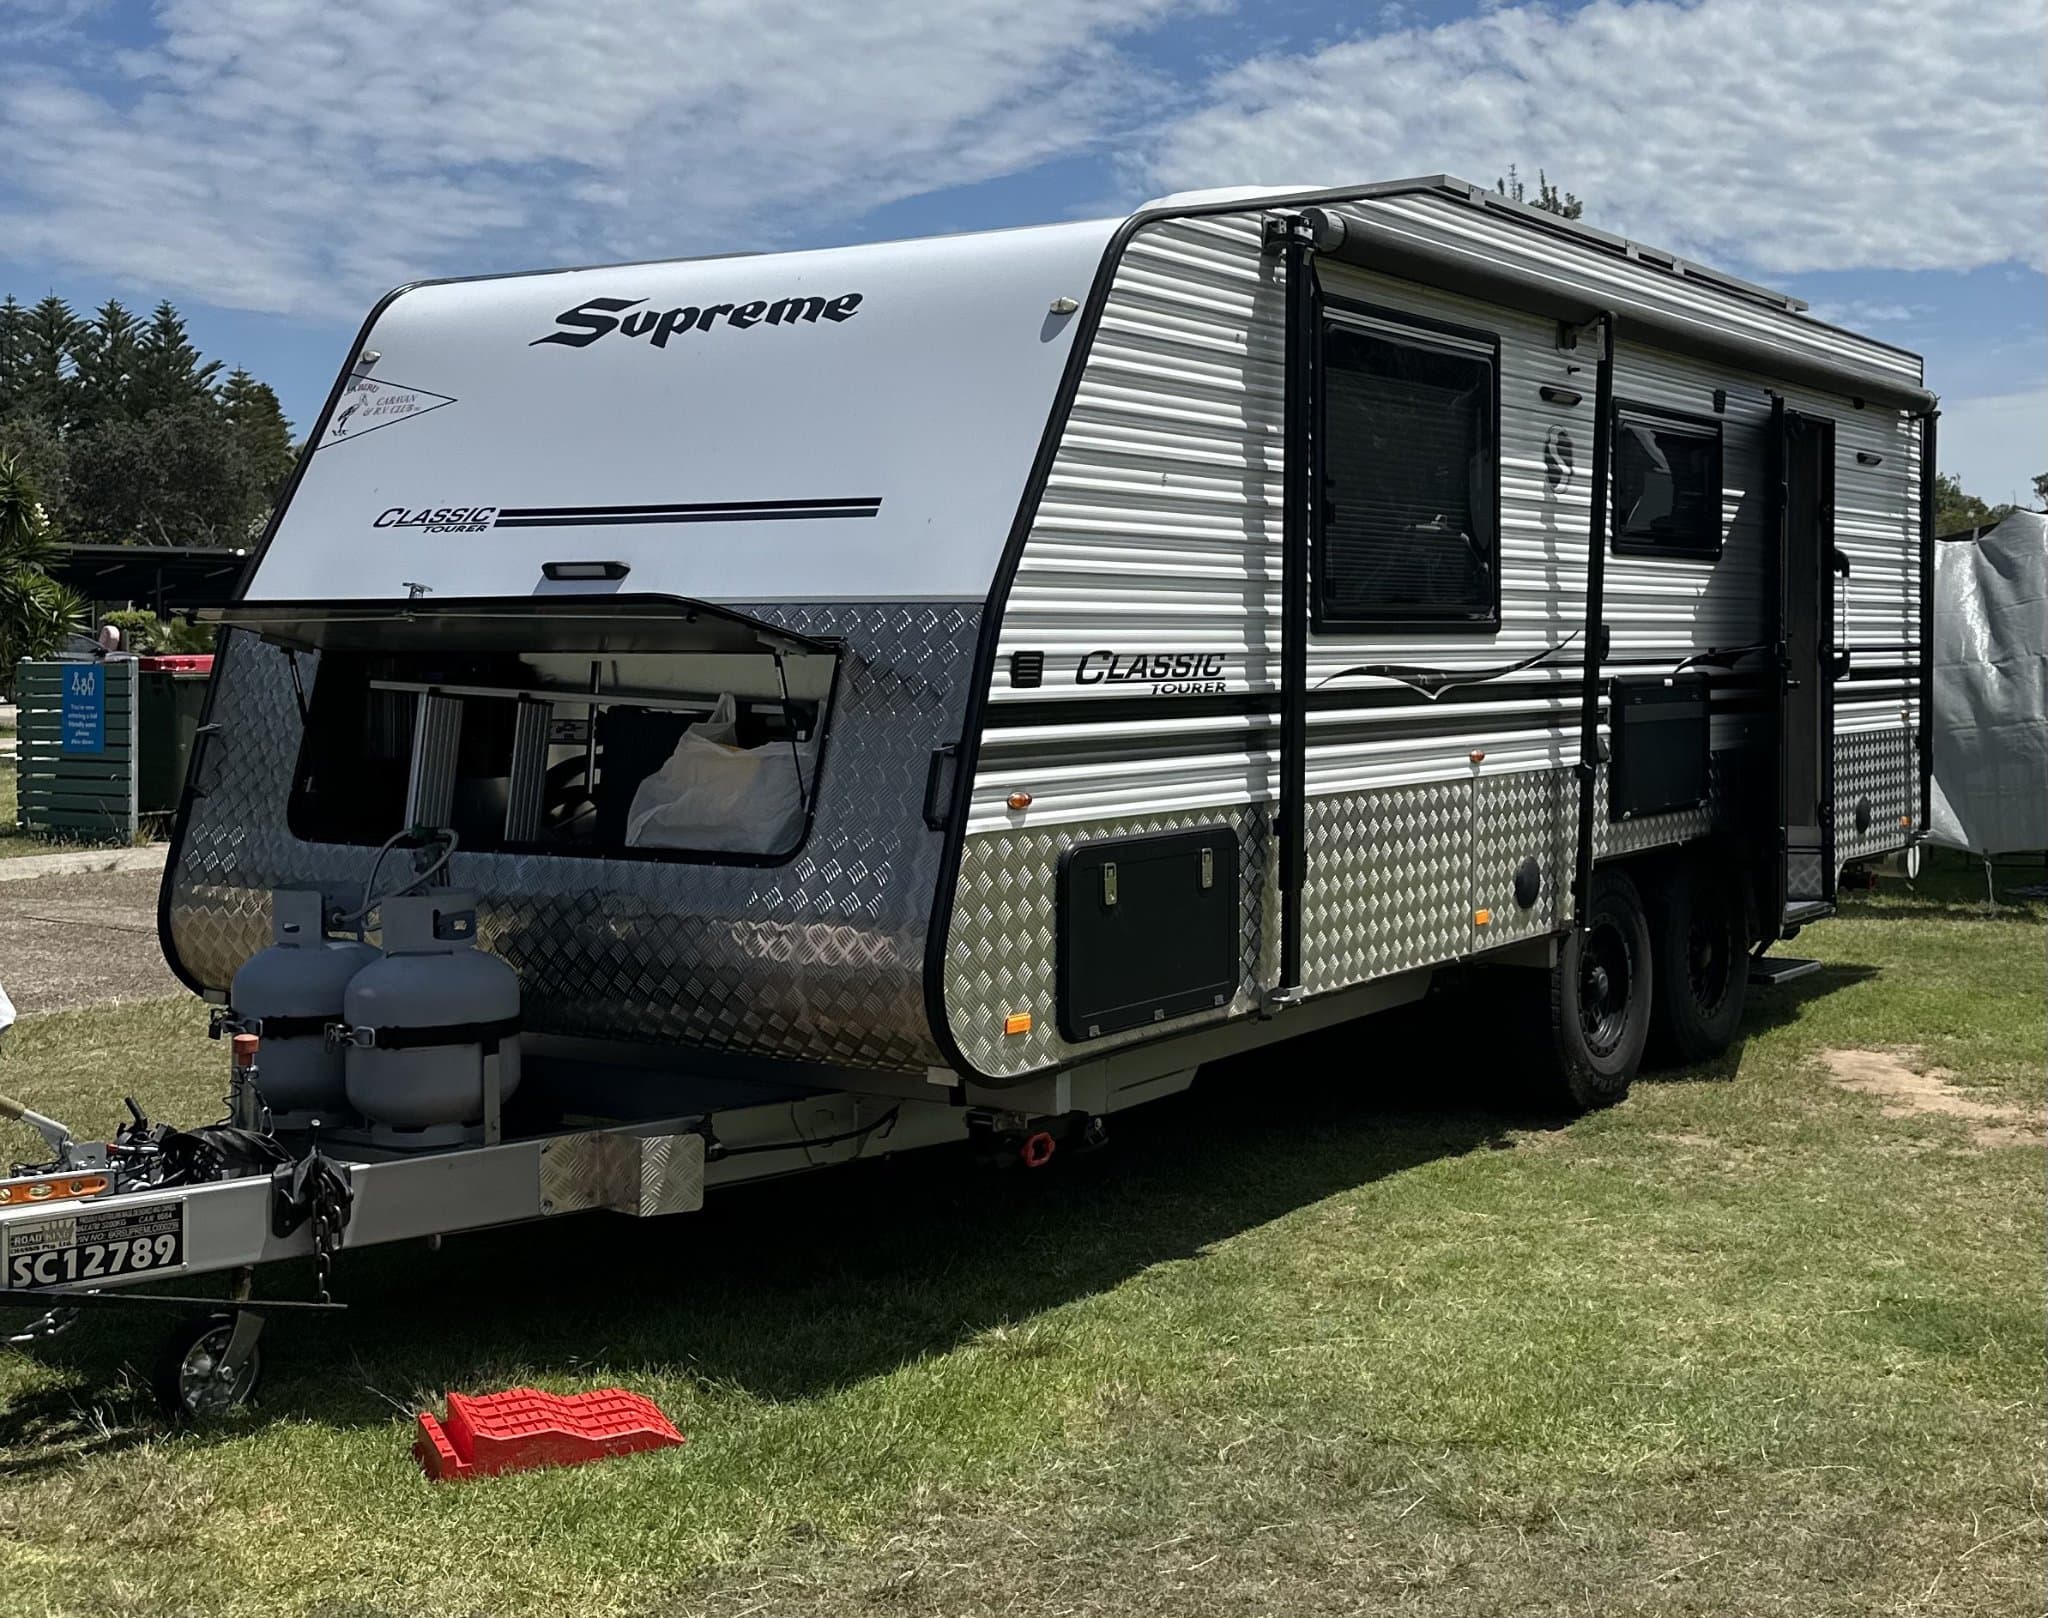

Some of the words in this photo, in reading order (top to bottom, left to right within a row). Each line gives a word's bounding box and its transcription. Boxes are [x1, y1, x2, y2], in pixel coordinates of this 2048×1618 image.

[528, 293, 863, 348] Supreme
[373, 507, 496, 528] CLASSIC
[422, 525, 487, 533] TOURER
[1075, 650, 1226, 685] CLASSIC
[1151, 682, 1226, 695] TOURER
[14, 1233, 42, 1246] ROAD
[13, 1234, 176, 1288] SC12789
